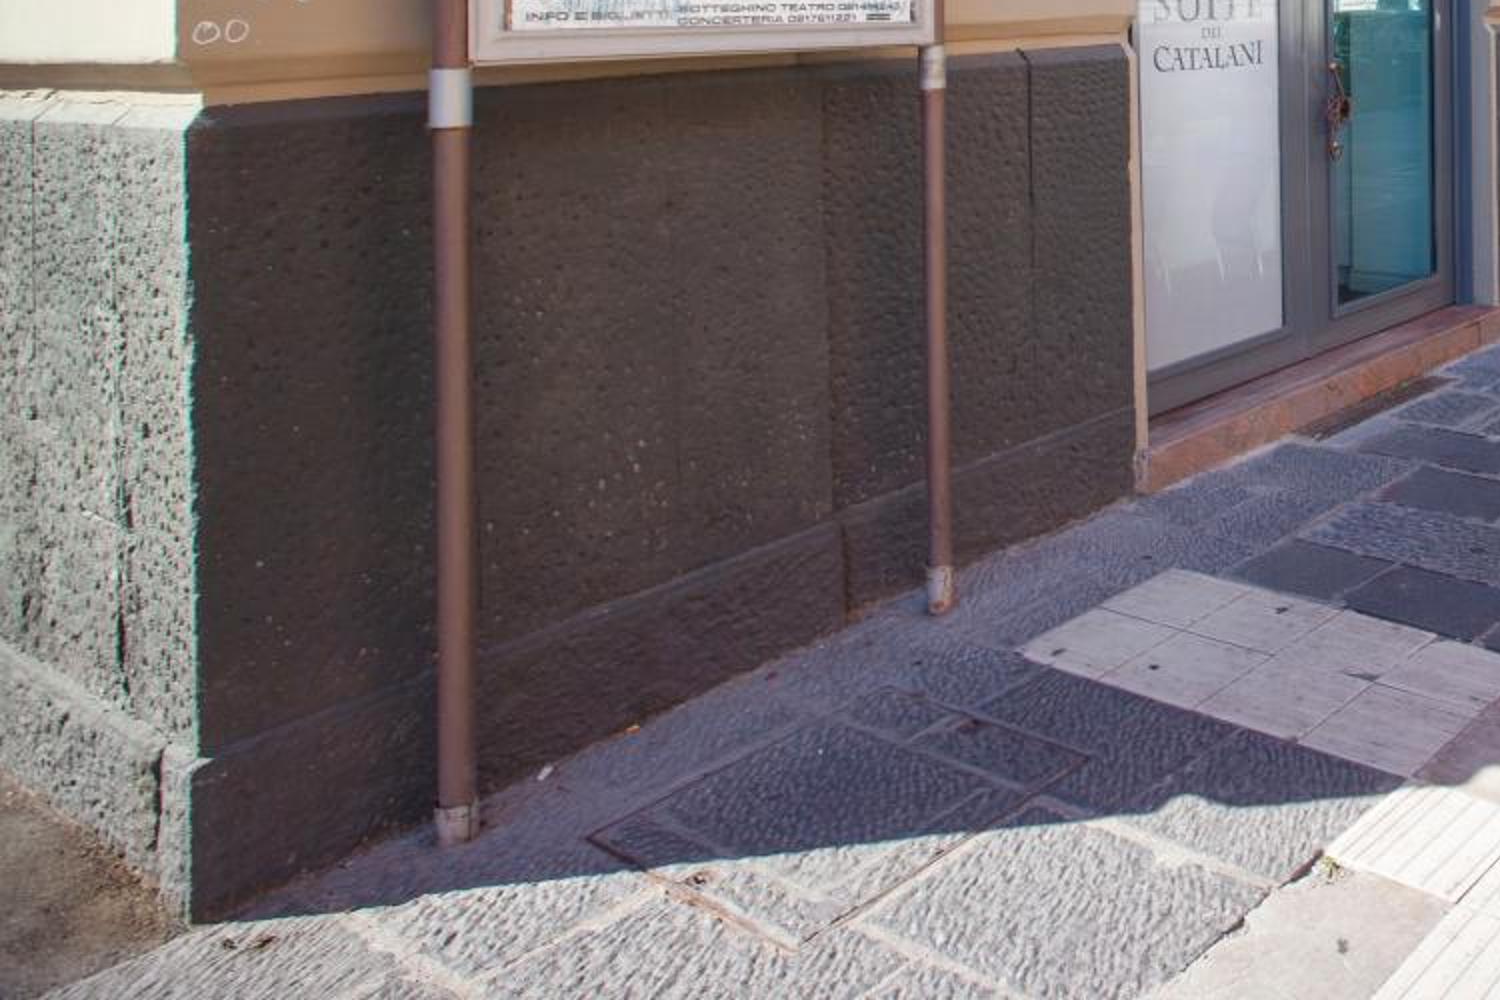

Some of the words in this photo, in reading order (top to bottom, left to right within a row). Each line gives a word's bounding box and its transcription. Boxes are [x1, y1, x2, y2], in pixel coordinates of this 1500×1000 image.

[781, 3, 835, 12] TEATRO
[525, 12, 569, 21] INFO
[575, 11, 588, 21] E
[1153, 40, 1263, 72] CATALANI
